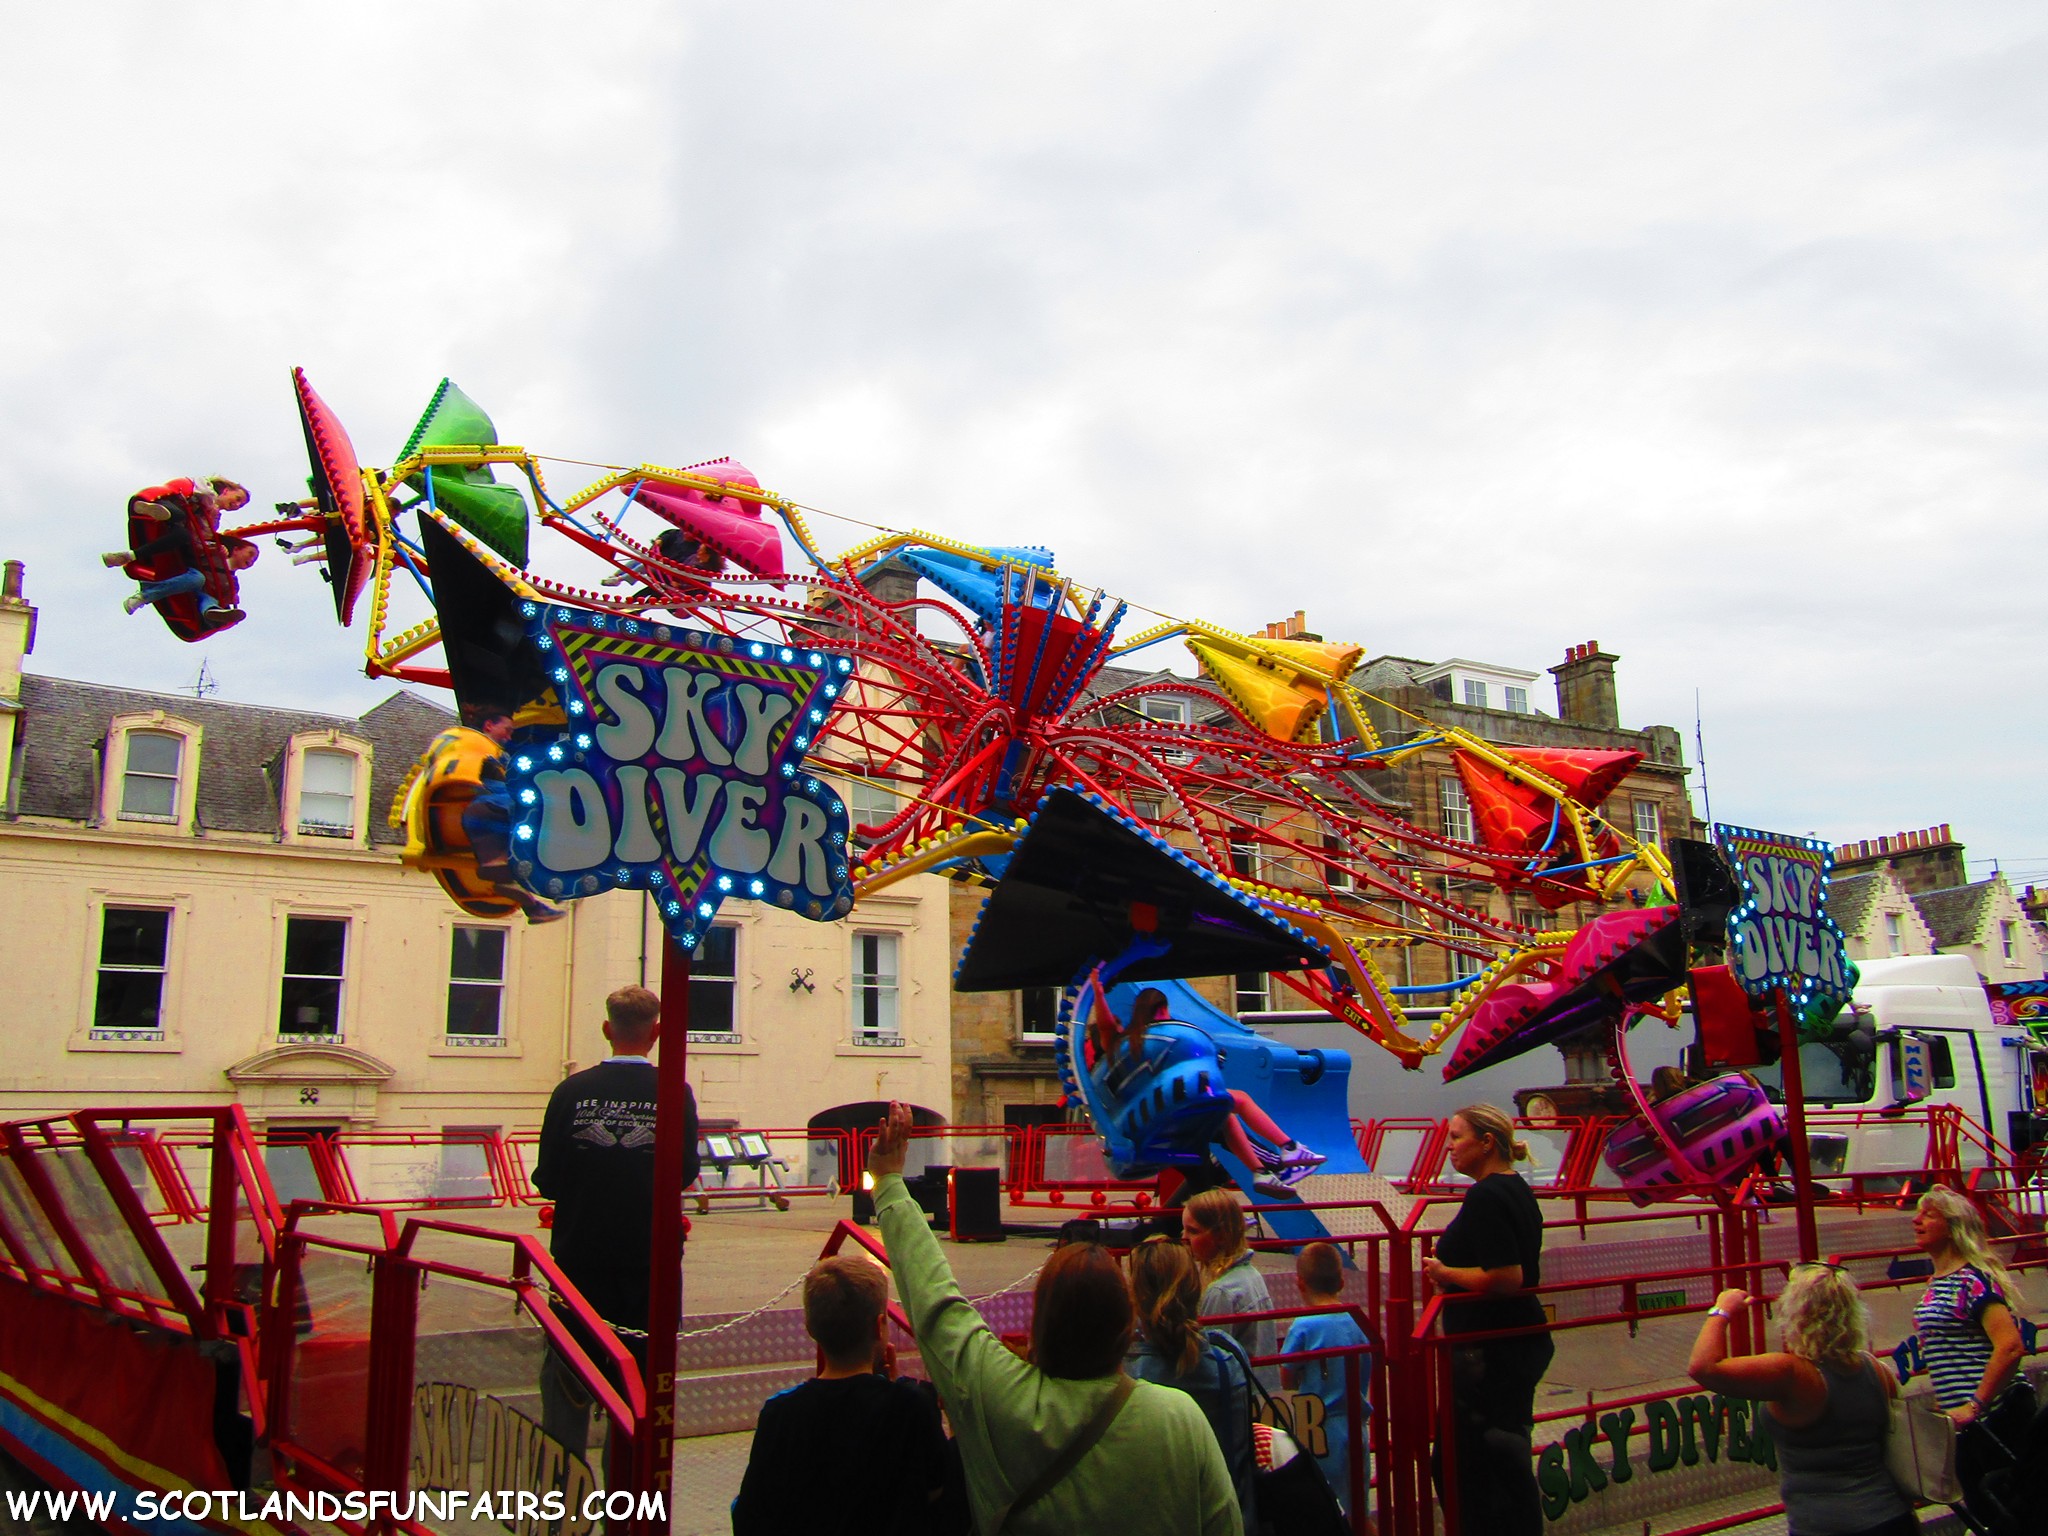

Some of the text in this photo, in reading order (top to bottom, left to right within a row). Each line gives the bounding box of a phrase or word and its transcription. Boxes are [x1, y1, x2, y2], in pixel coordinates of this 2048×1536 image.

[595, 663, 792, 776] SKY
[533, 765, 832, 896] DIVER
[1747, 856, 1815, 918] SKY
[1736, 915, 1844, 988] DIVER
[1343, 1006, 1362, 1025] EXIT
[576, 1099, 658, 1110] BEE INSPIRE
[618, 1120, 656, 1128] EXCELLEN
[415, 1381, 478, 1492] SKY
[655, 1373, 673, 1491] EXIT
[1537, 1407, 1636, 1522] SKY
